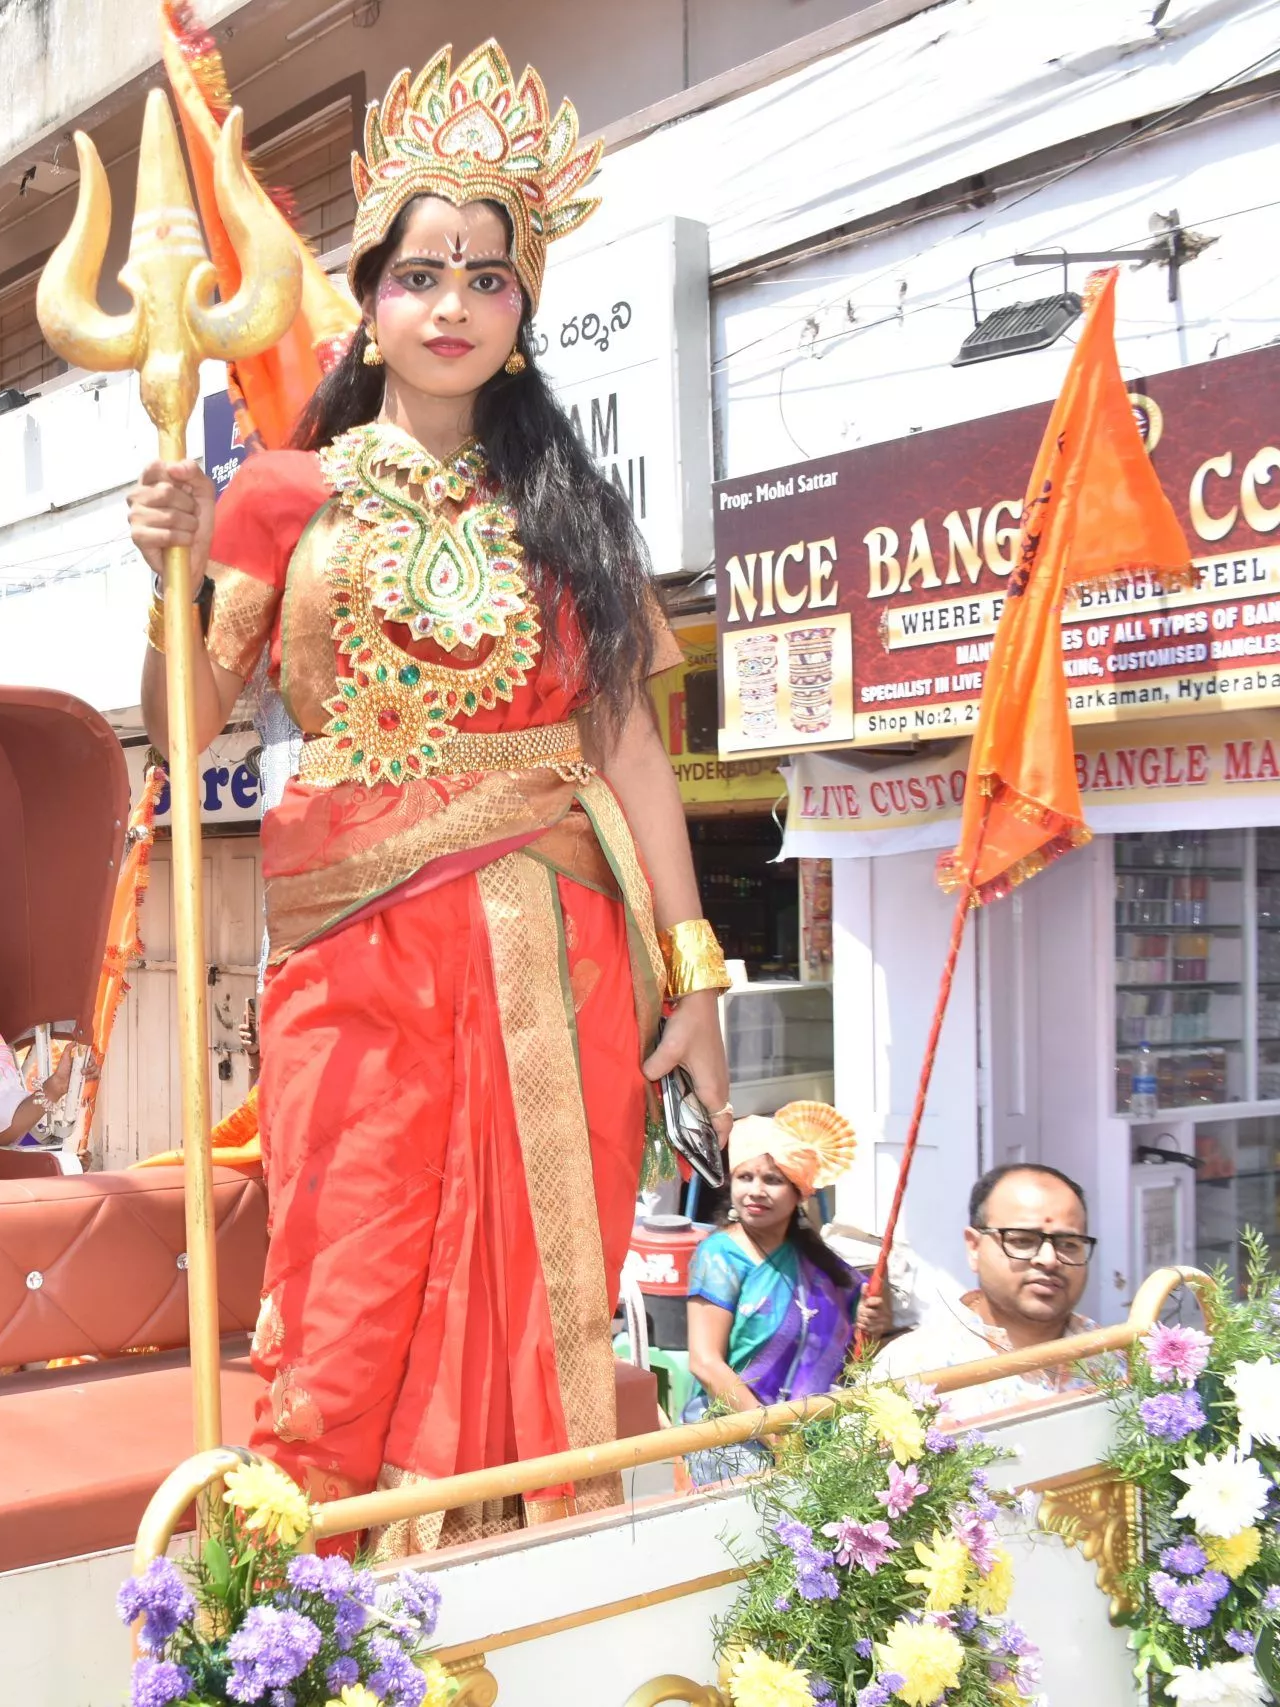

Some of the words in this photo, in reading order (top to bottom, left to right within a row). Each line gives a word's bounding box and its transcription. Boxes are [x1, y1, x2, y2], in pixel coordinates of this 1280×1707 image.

[211, 457, 239, 480] Taste
[720, 492, 753, 510] Prop:
[756, 477, 794, 503] Mohd
[797, 471, 839, 494] Sattar
[724, 536, 839, 623] NICE
[862, 498, 1024, 599] BANG
[901, 602, 981, 636] WHERE
[1086, 625, 1110, 647] OF
[1114, 620, 1147, 644] ALL
[1149, 611, 1208, 639] TYPES
[1212, 606, 1239, 630] OF
[861, 678, 932, 703] SPECIALIST
[935, 675, 950, 693] IN
[952, 671, 983, 691] LIVE
[1062, 656, 1104, 677] KING,
[1106, 643, 1209, 673] CUSTOMISED
[868, 713, 908, 733] Shop
[800, 785, 861, 818] LIVE
[869, 769, 967, 815] CUSTO
